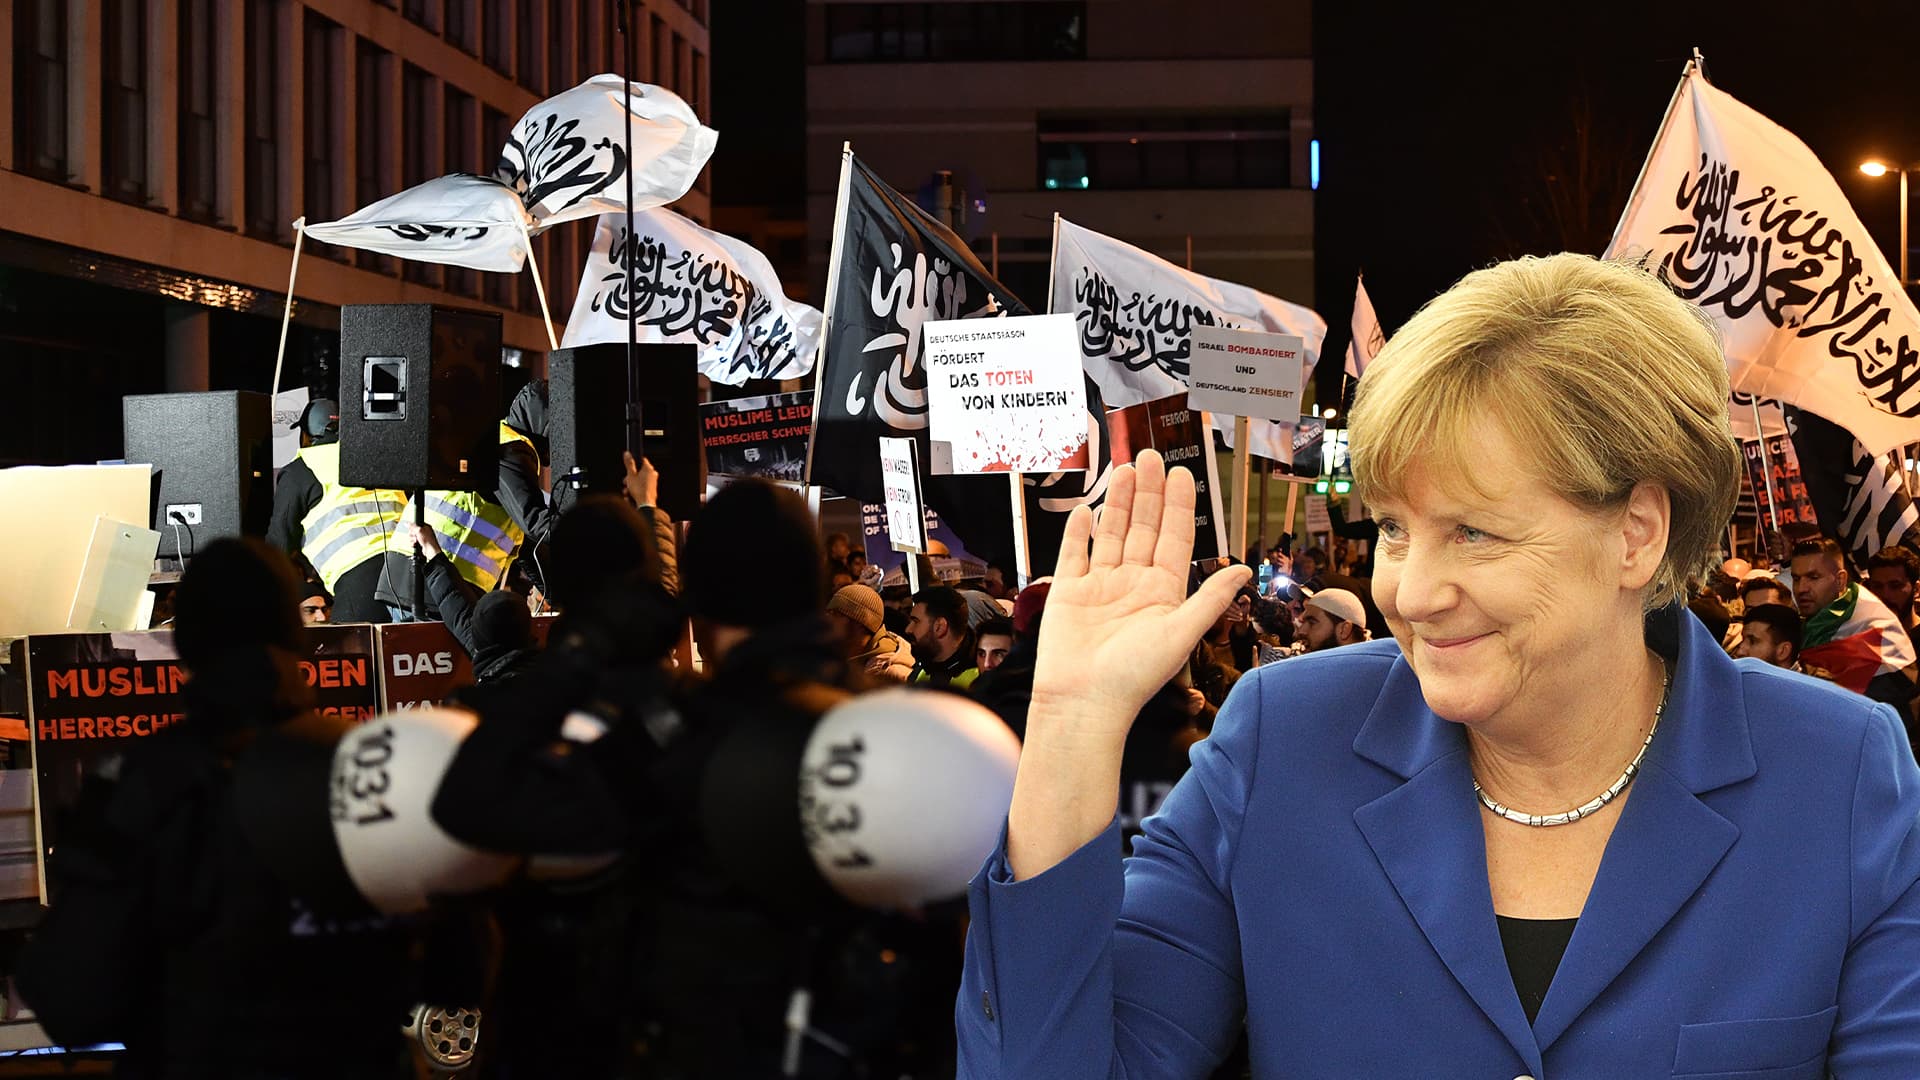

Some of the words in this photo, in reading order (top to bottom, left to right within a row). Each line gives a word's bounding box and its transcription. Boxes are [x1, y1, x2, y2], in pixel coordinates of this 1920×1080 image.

[930, 334, 970, 344] DEUTSCHE
[933, 349, 985, 365] FÖRDERT
[1198, 342, 1225, 352] ISRAEL
[1228, 344, 1296, 359] BOMBARDIERT
[950, 373, 979, 388] DAS
[985, 365, 1034, 386] TÖTEN
[1235, 365, 1256, 375] UND
[1196, 382, 1247, 394] DEUTSCHLAND
[1249, 387, 1295, 399] ZENSIERT
[962, 394, 995, 410] VON
[1001, 391, 1067, 408] KINDERN
[705, 410, 774, 429] MUSLIME
[778, 405, 813, 421] LEID
[1160, 410, 1191, 427] TERROR
[704, 431, 769, 447] HERRSCHER
[392, 651, 454, 677] DAS
